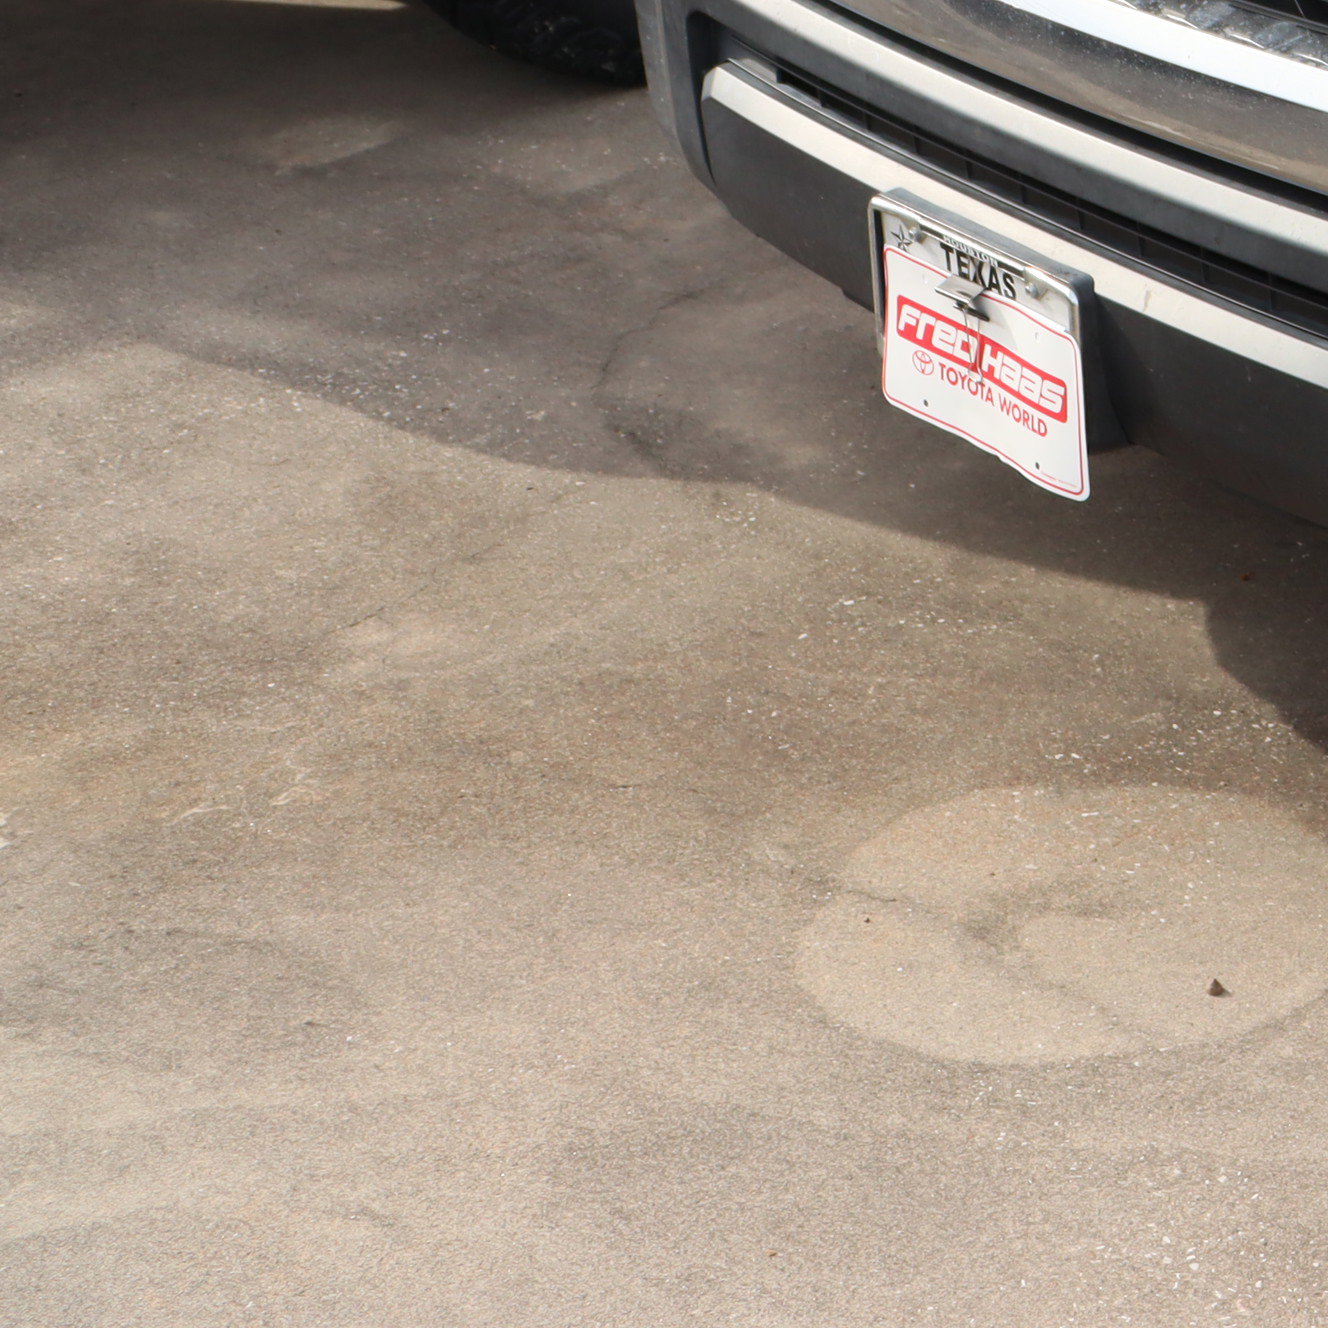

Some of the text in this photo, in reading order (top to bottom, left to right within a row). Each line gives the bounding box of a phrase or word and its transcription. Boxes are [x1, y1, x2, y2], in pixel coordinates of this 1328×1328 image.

[940, 242, 1016, 301] TEXAS
[939, 362, 1048, 437] TOYOTA WORLD
